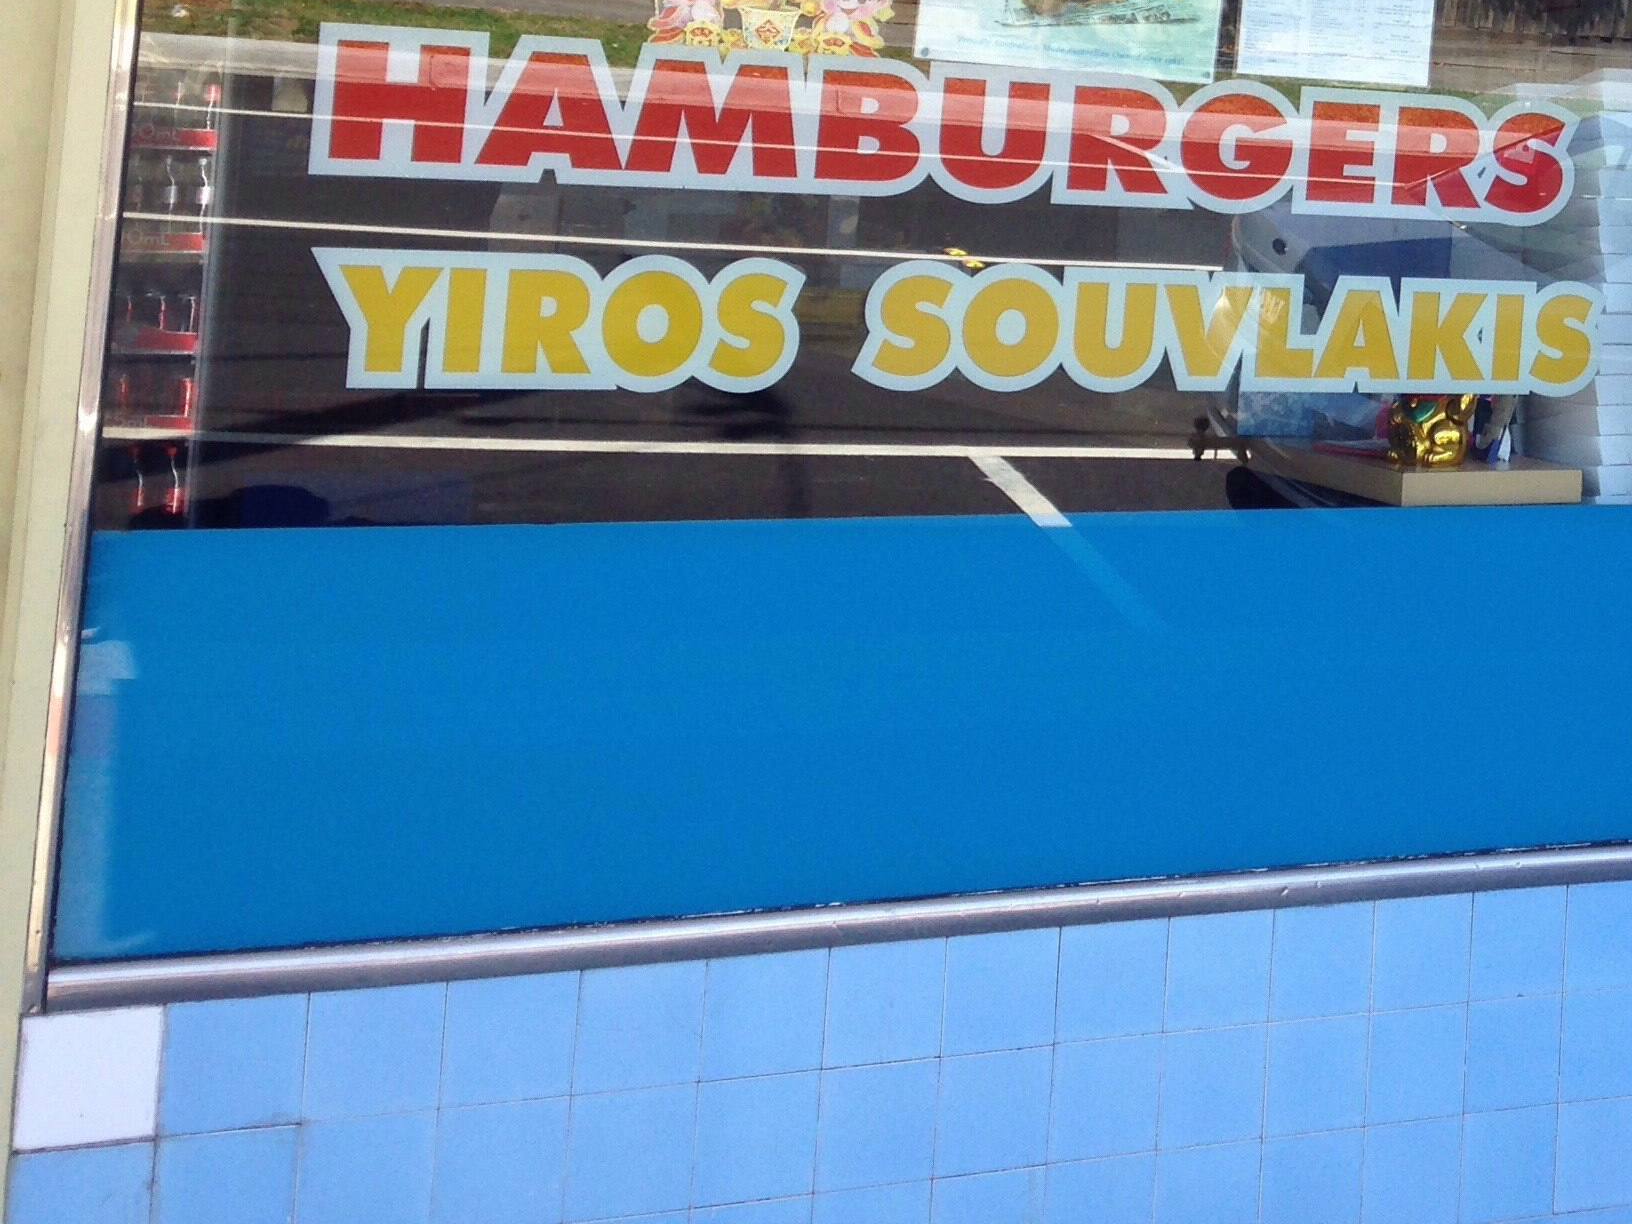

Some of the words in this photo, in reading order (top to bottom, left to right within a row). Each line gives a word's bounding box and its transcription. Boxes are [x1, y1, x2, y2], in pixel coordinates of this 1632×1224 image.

[307, 21, 1577, 227] HAMBURGERS
[309, 246, 806, 393] YIROS
[852, 260, 1605, 397] SOUVLAKIS
